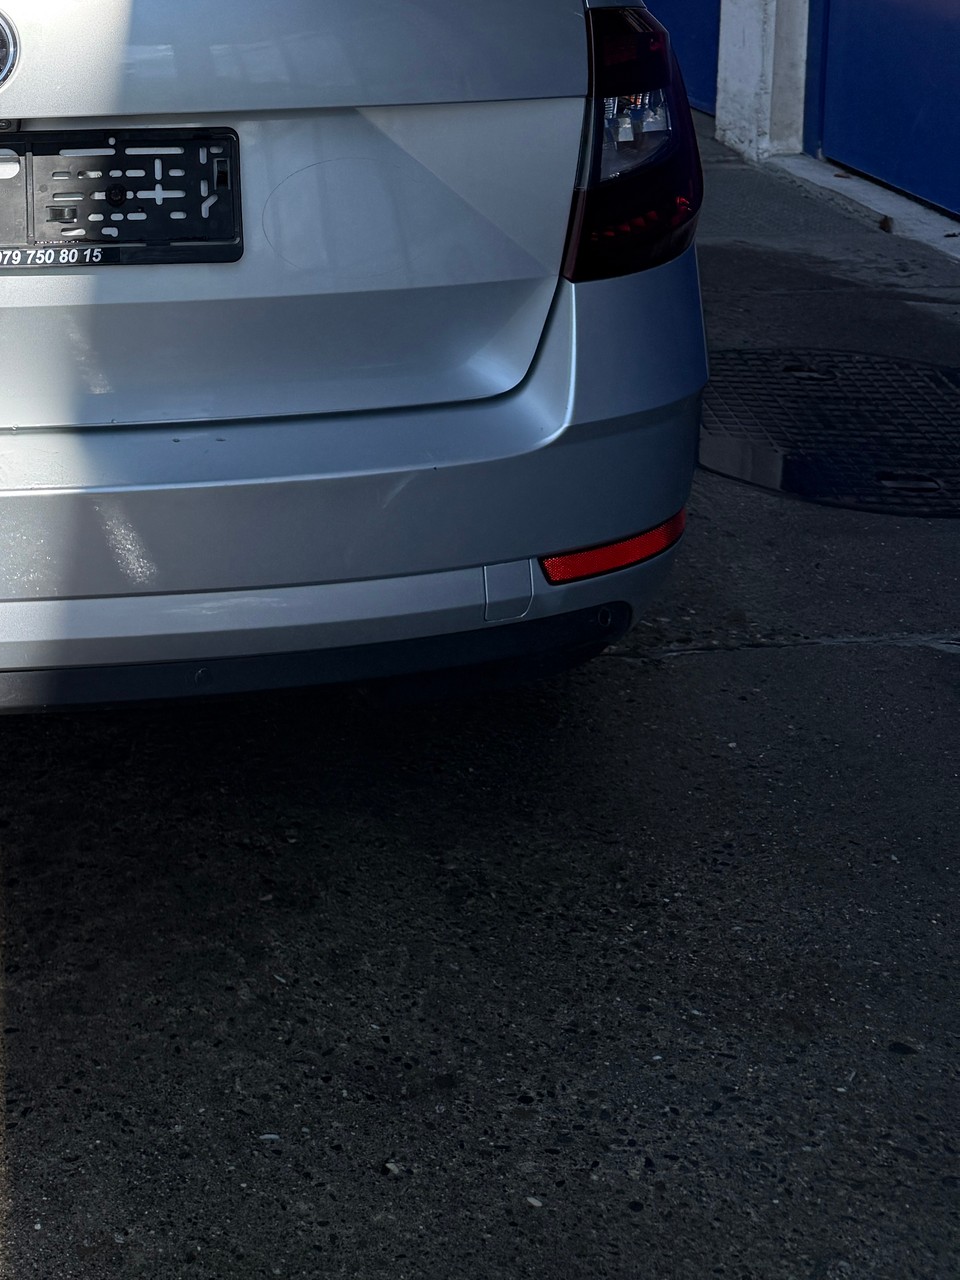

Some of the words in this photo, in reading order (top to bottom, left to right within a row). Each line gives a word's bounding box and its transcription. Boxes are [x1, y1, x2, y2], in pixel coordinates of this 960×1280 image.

[26, 249, 55, 264] 750
[59, 248, 79, 263] 80
[83, 248, 102, 262] 15
